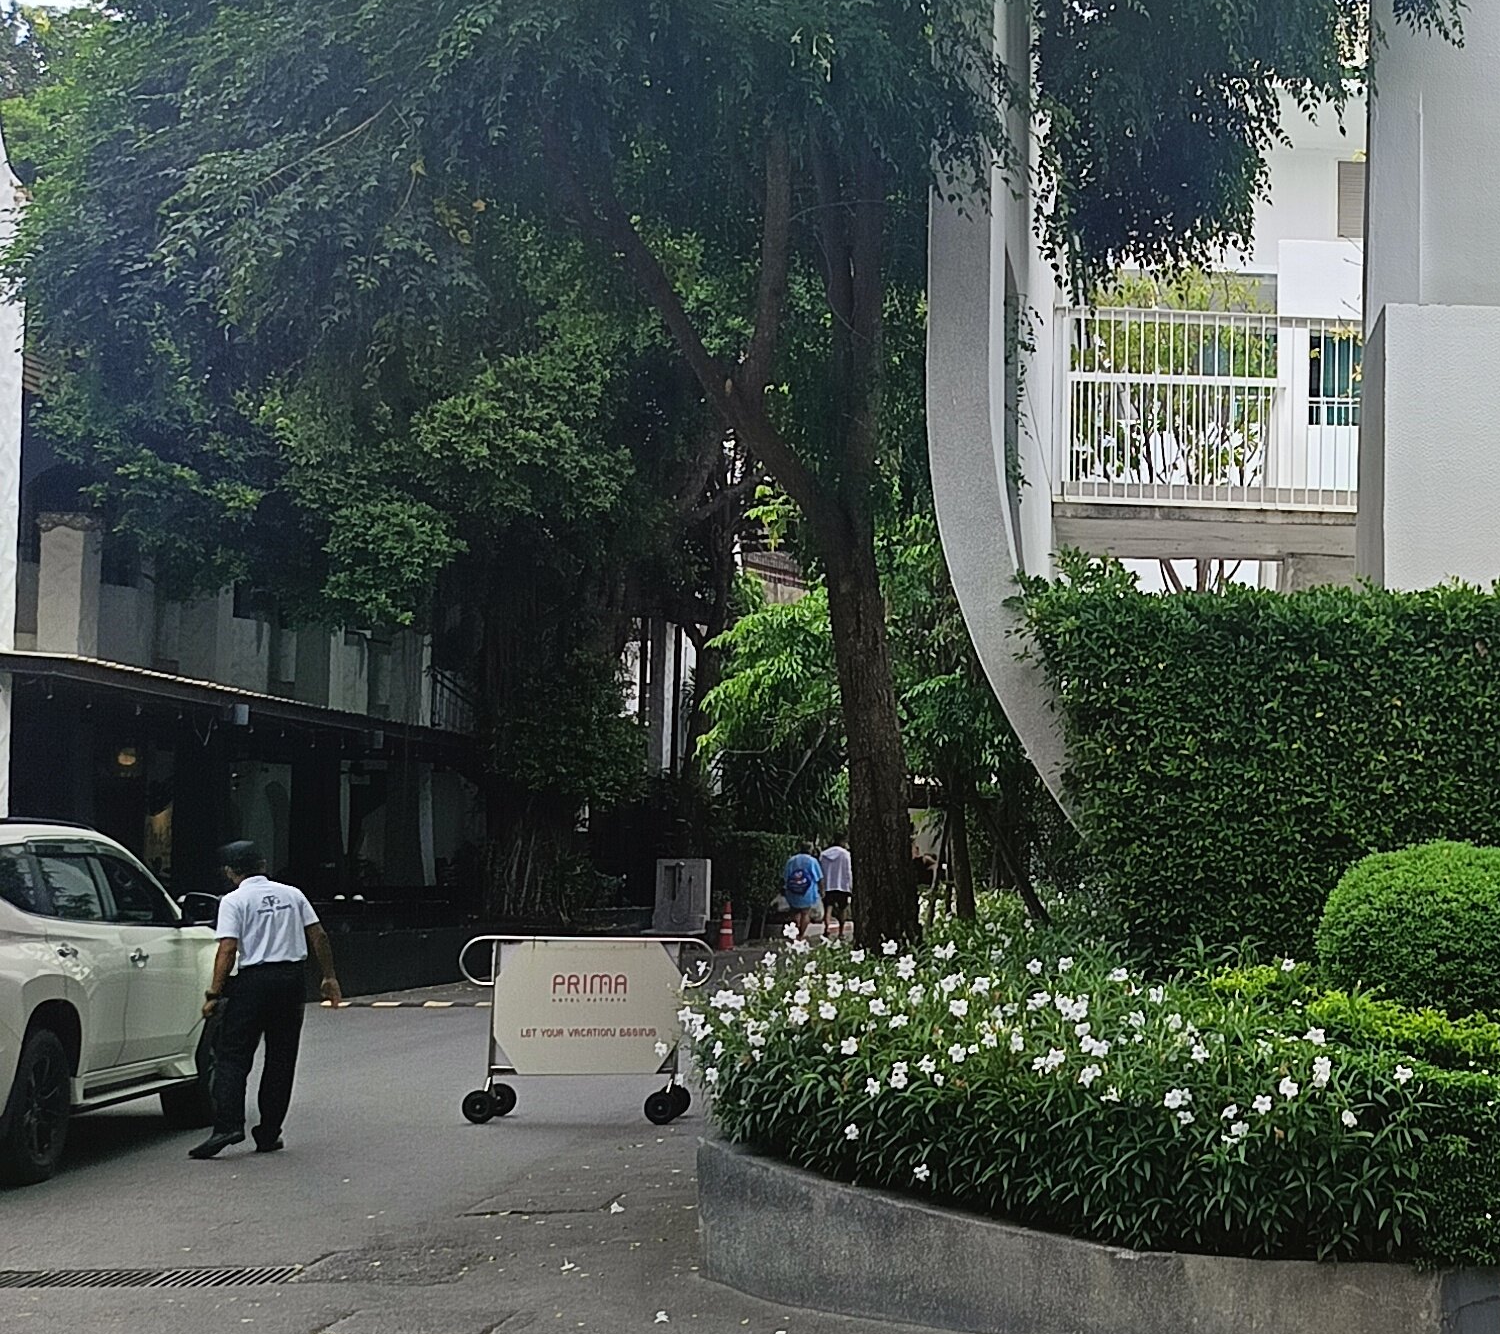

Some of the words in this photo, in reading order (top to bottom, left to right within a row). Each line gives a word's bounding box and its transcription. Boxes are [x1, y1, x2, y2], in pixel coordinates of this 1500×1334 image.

[552, 974, 628, 995] PRIMA
[541, 1028, 564, 1038] YOUR
[568, 1028, 617, 1038] VACATION
